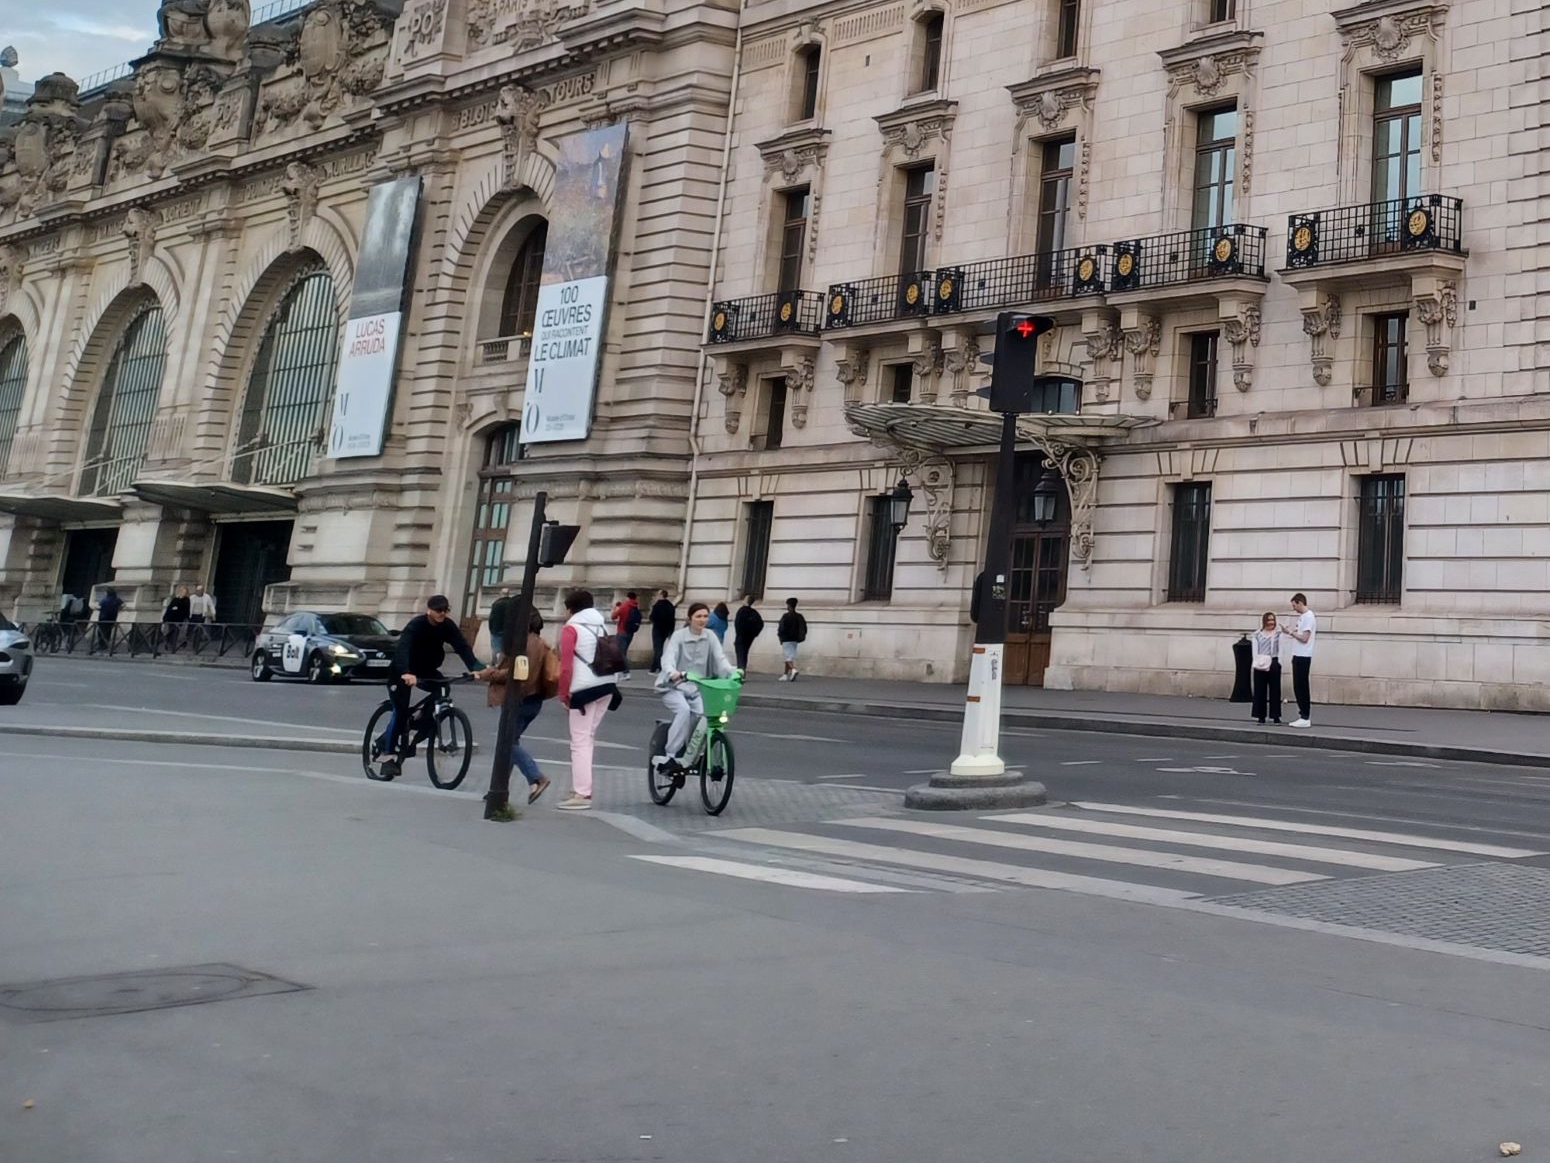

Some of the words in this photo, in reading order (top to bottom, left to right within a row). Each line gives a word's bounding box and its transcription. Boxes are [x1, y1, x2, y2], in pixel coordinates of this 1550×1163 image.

[551, 72, 594, 103] TOURS
[560, 285, 579, 305] 100
[541, 303, 592, 328] ŒUVRES
[356, 318, 385, 338] LUCAS
[348, 338, 385, 357] ARRUDA
[534, 343, 548, 362] LE
[549, 337, 592, 360] CLIMAT
[286, 643, 300, 660] Bolt
